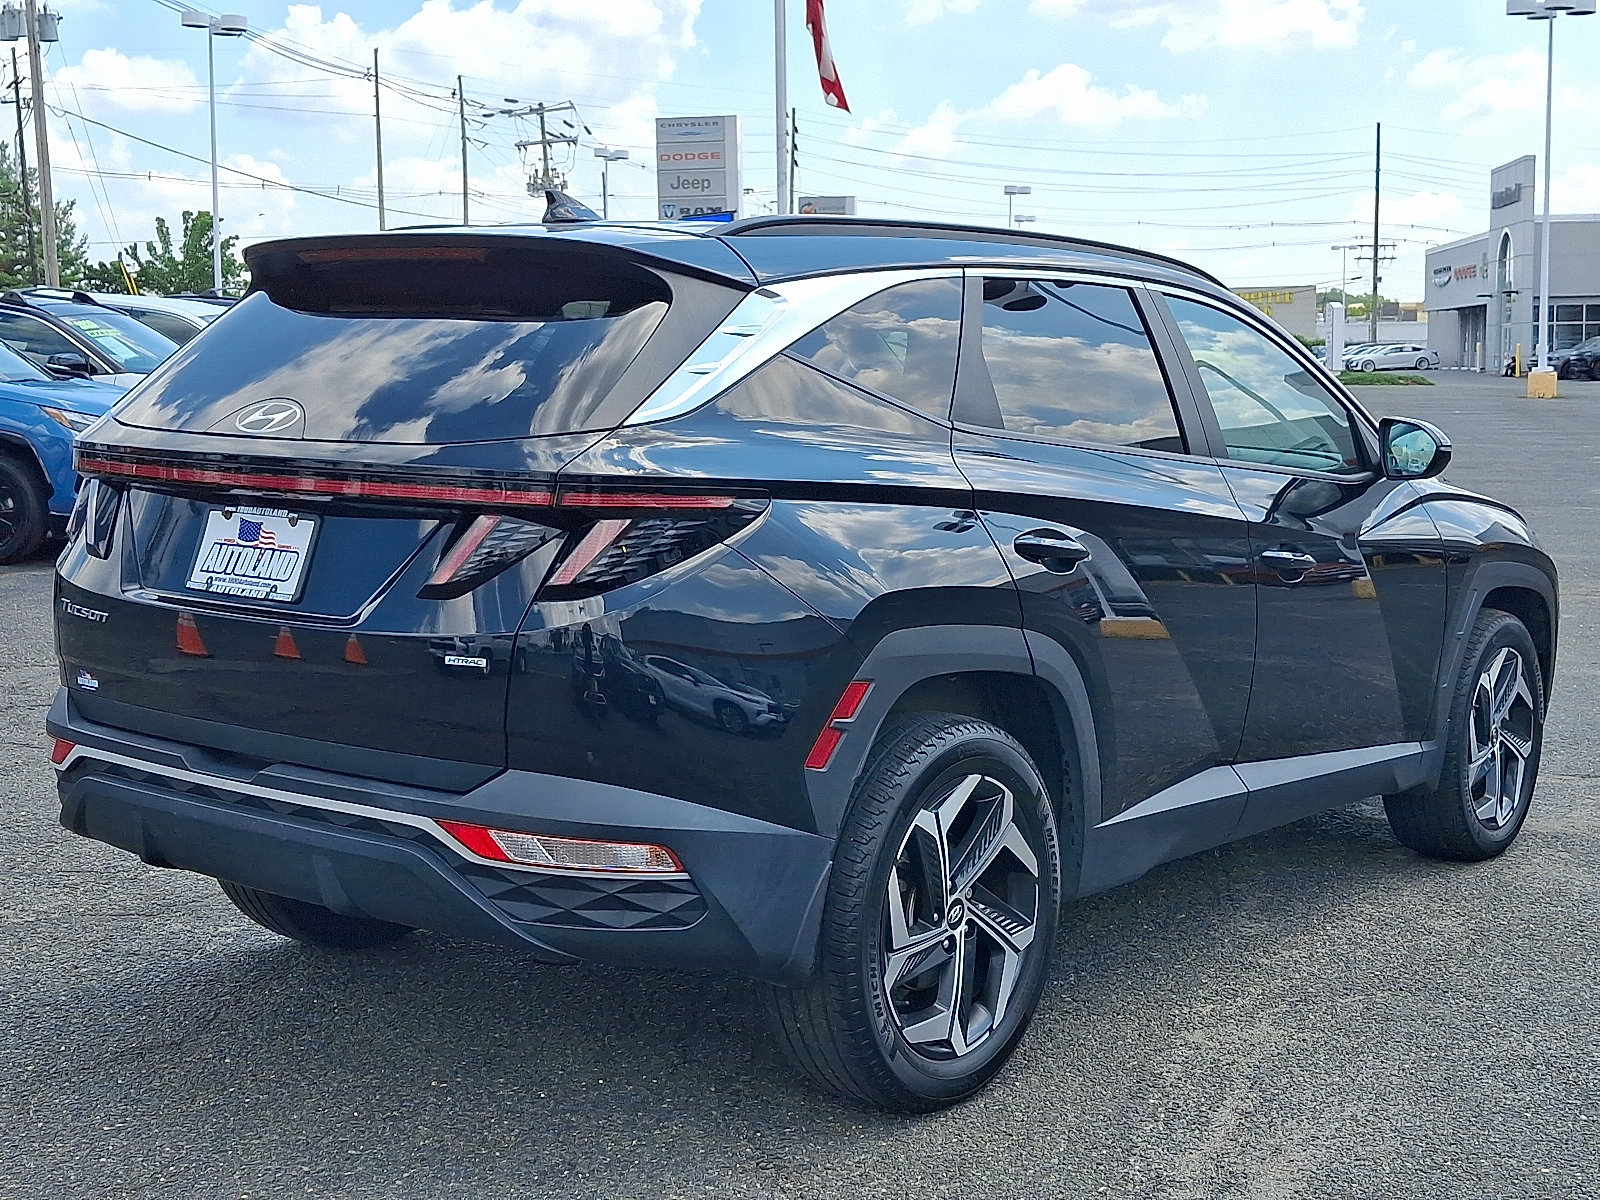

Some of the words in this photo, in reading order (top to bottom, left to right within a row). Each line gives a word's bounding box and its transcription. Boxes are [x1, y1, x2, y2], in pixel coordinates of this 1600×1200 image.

[660, 121, 720, 129] CHRYSLER
[660, 152, 721, 162] DODGE
[670, 175, 712, 193] Jeep
[201, 543, 299, 581] AUTOLAND
[208, 583, 269, 600] AUTOLAND
[447, 657, 483, 666] HTRAC
